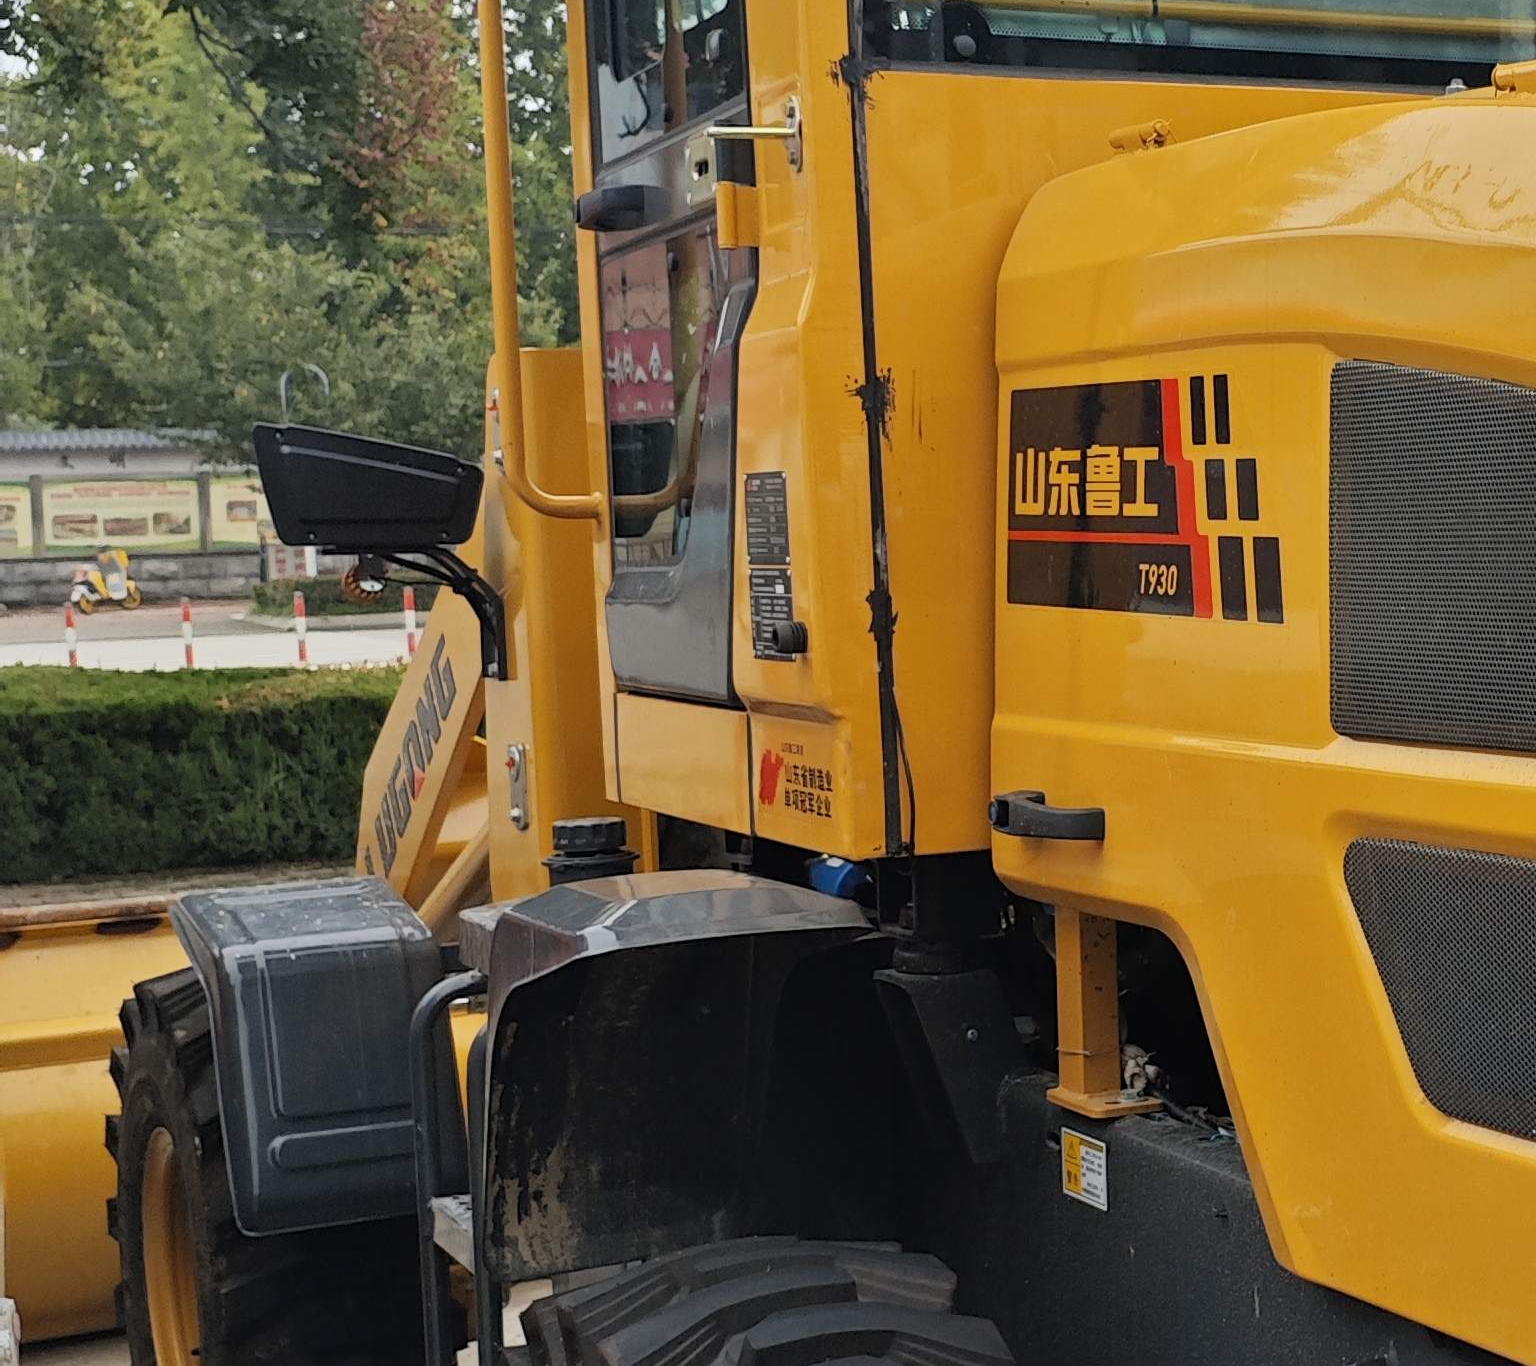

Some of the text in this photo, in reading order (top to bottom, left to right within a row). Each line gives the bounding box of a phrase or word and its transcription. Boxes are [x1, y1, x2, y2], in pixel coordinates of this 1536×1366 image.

[1014, 444, 1160, 517] 山东鲁工
[1138, 563, 1178, 596] T930
